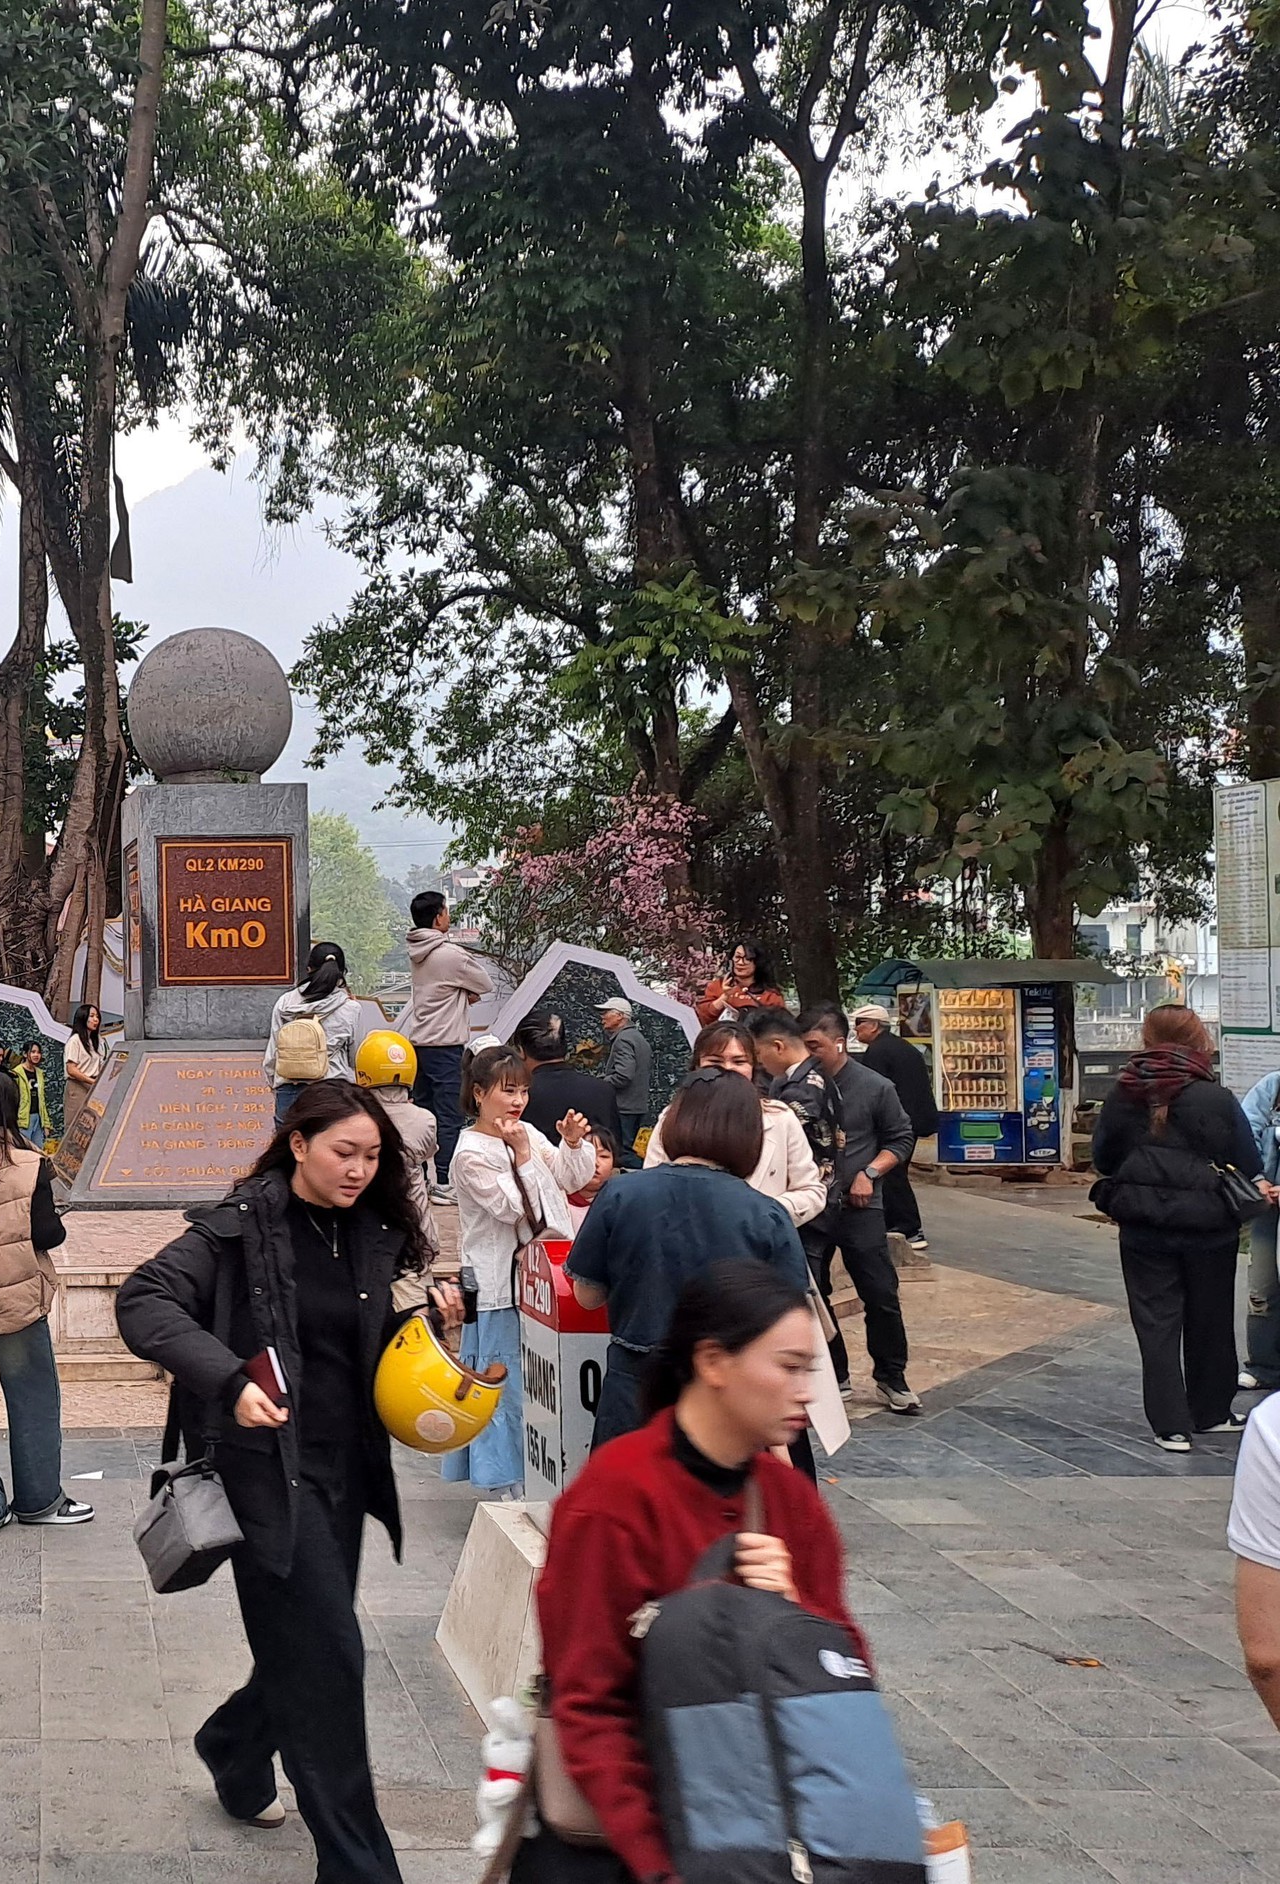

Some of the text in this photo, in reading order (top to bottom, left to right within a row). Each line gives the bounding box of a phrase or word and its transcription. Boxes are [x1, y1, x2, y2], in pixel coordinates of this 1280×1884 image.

[185, 858, 264, 871] QL2 KM290
[180, 893, 272, 912] HÀ GIANG
[162, 1121, 205, 1131] GIANG
[535, 1276, 551, 1316] 290
[526, 1422, 557, 1487] 155 Km
